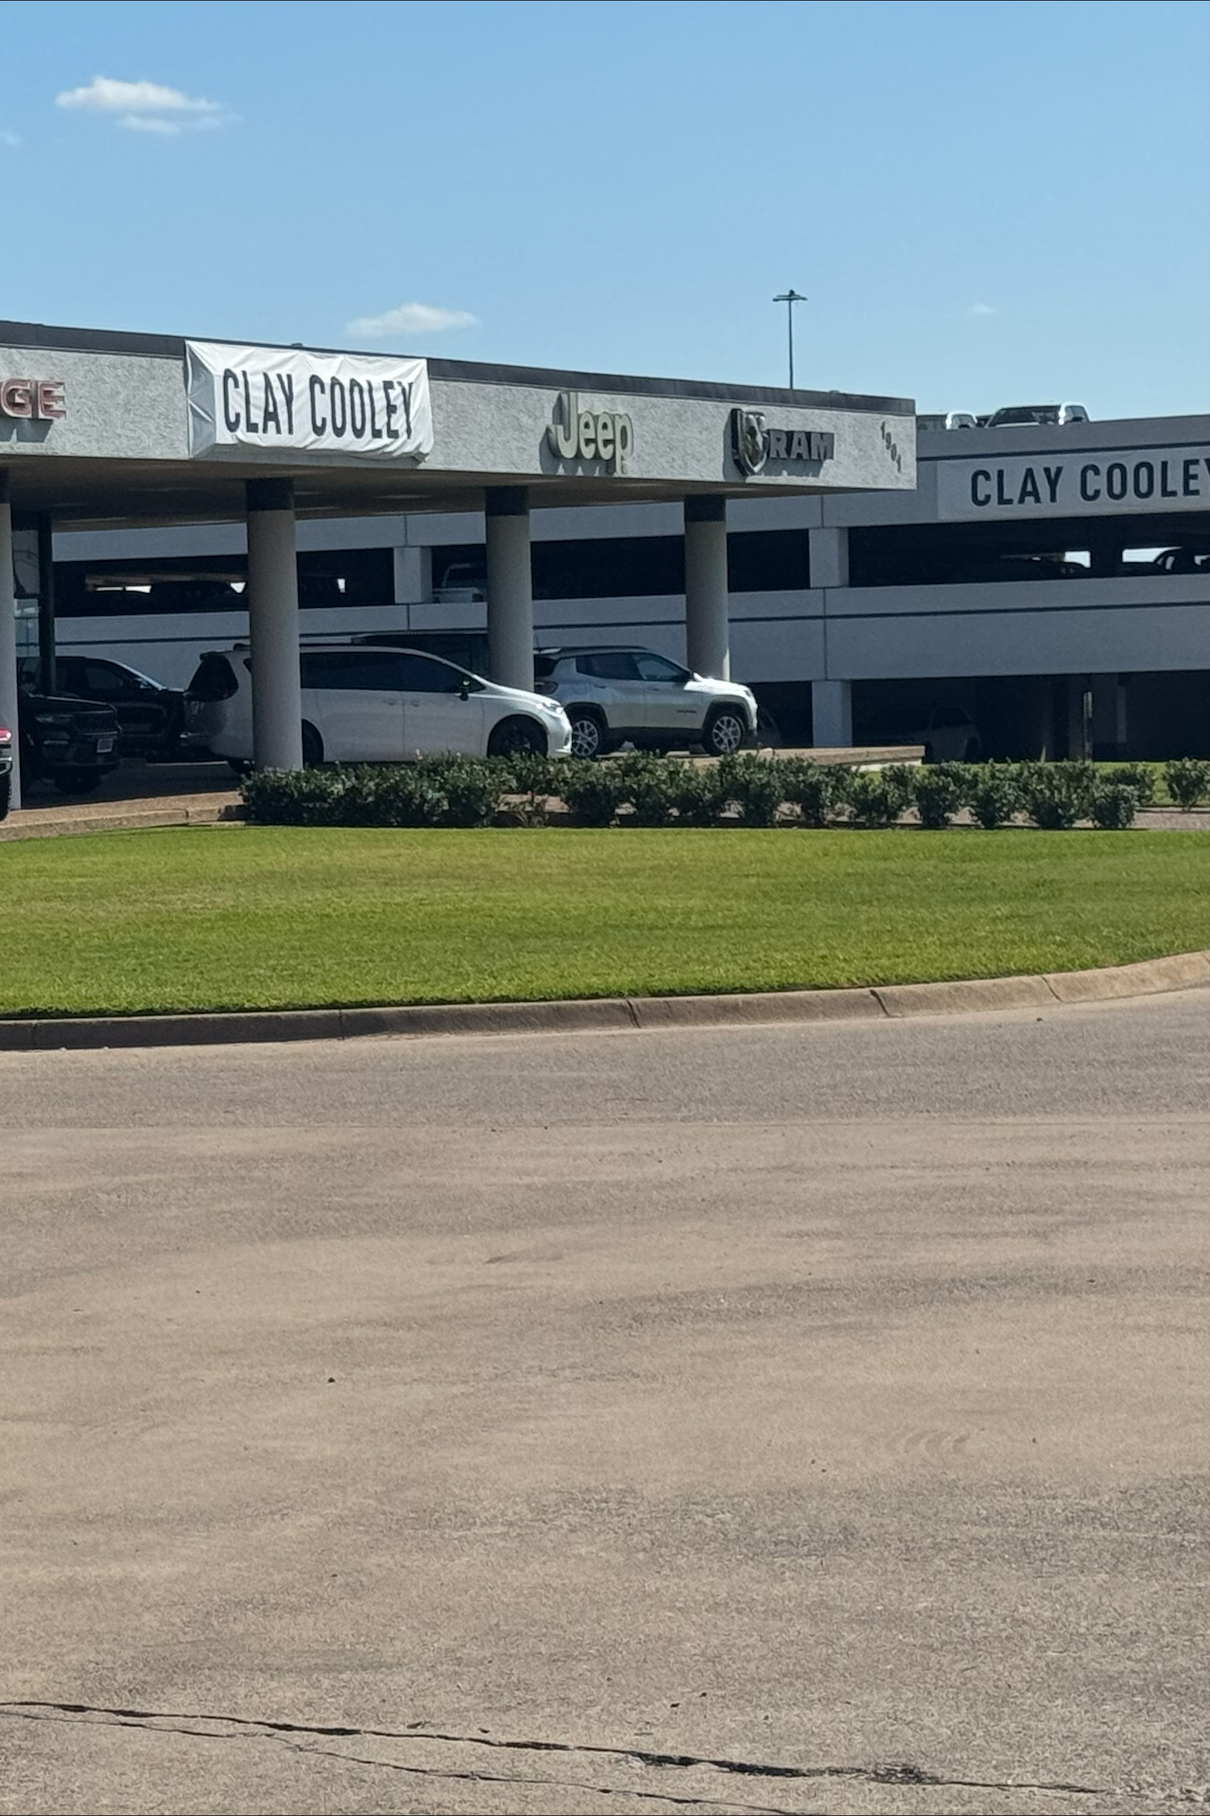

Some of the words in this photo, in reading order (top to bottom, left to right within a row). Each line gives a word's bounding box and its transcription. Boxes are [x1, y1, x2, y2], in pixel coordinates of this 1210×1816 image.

[223, 368, 294, 435] CLAY
[309, 374, 413, 439] COOLEY
[554, 391, 634, 477] Jeep
[768, 429, 835, 461] RAM
[971, 466, 1063, 506] CLAY
